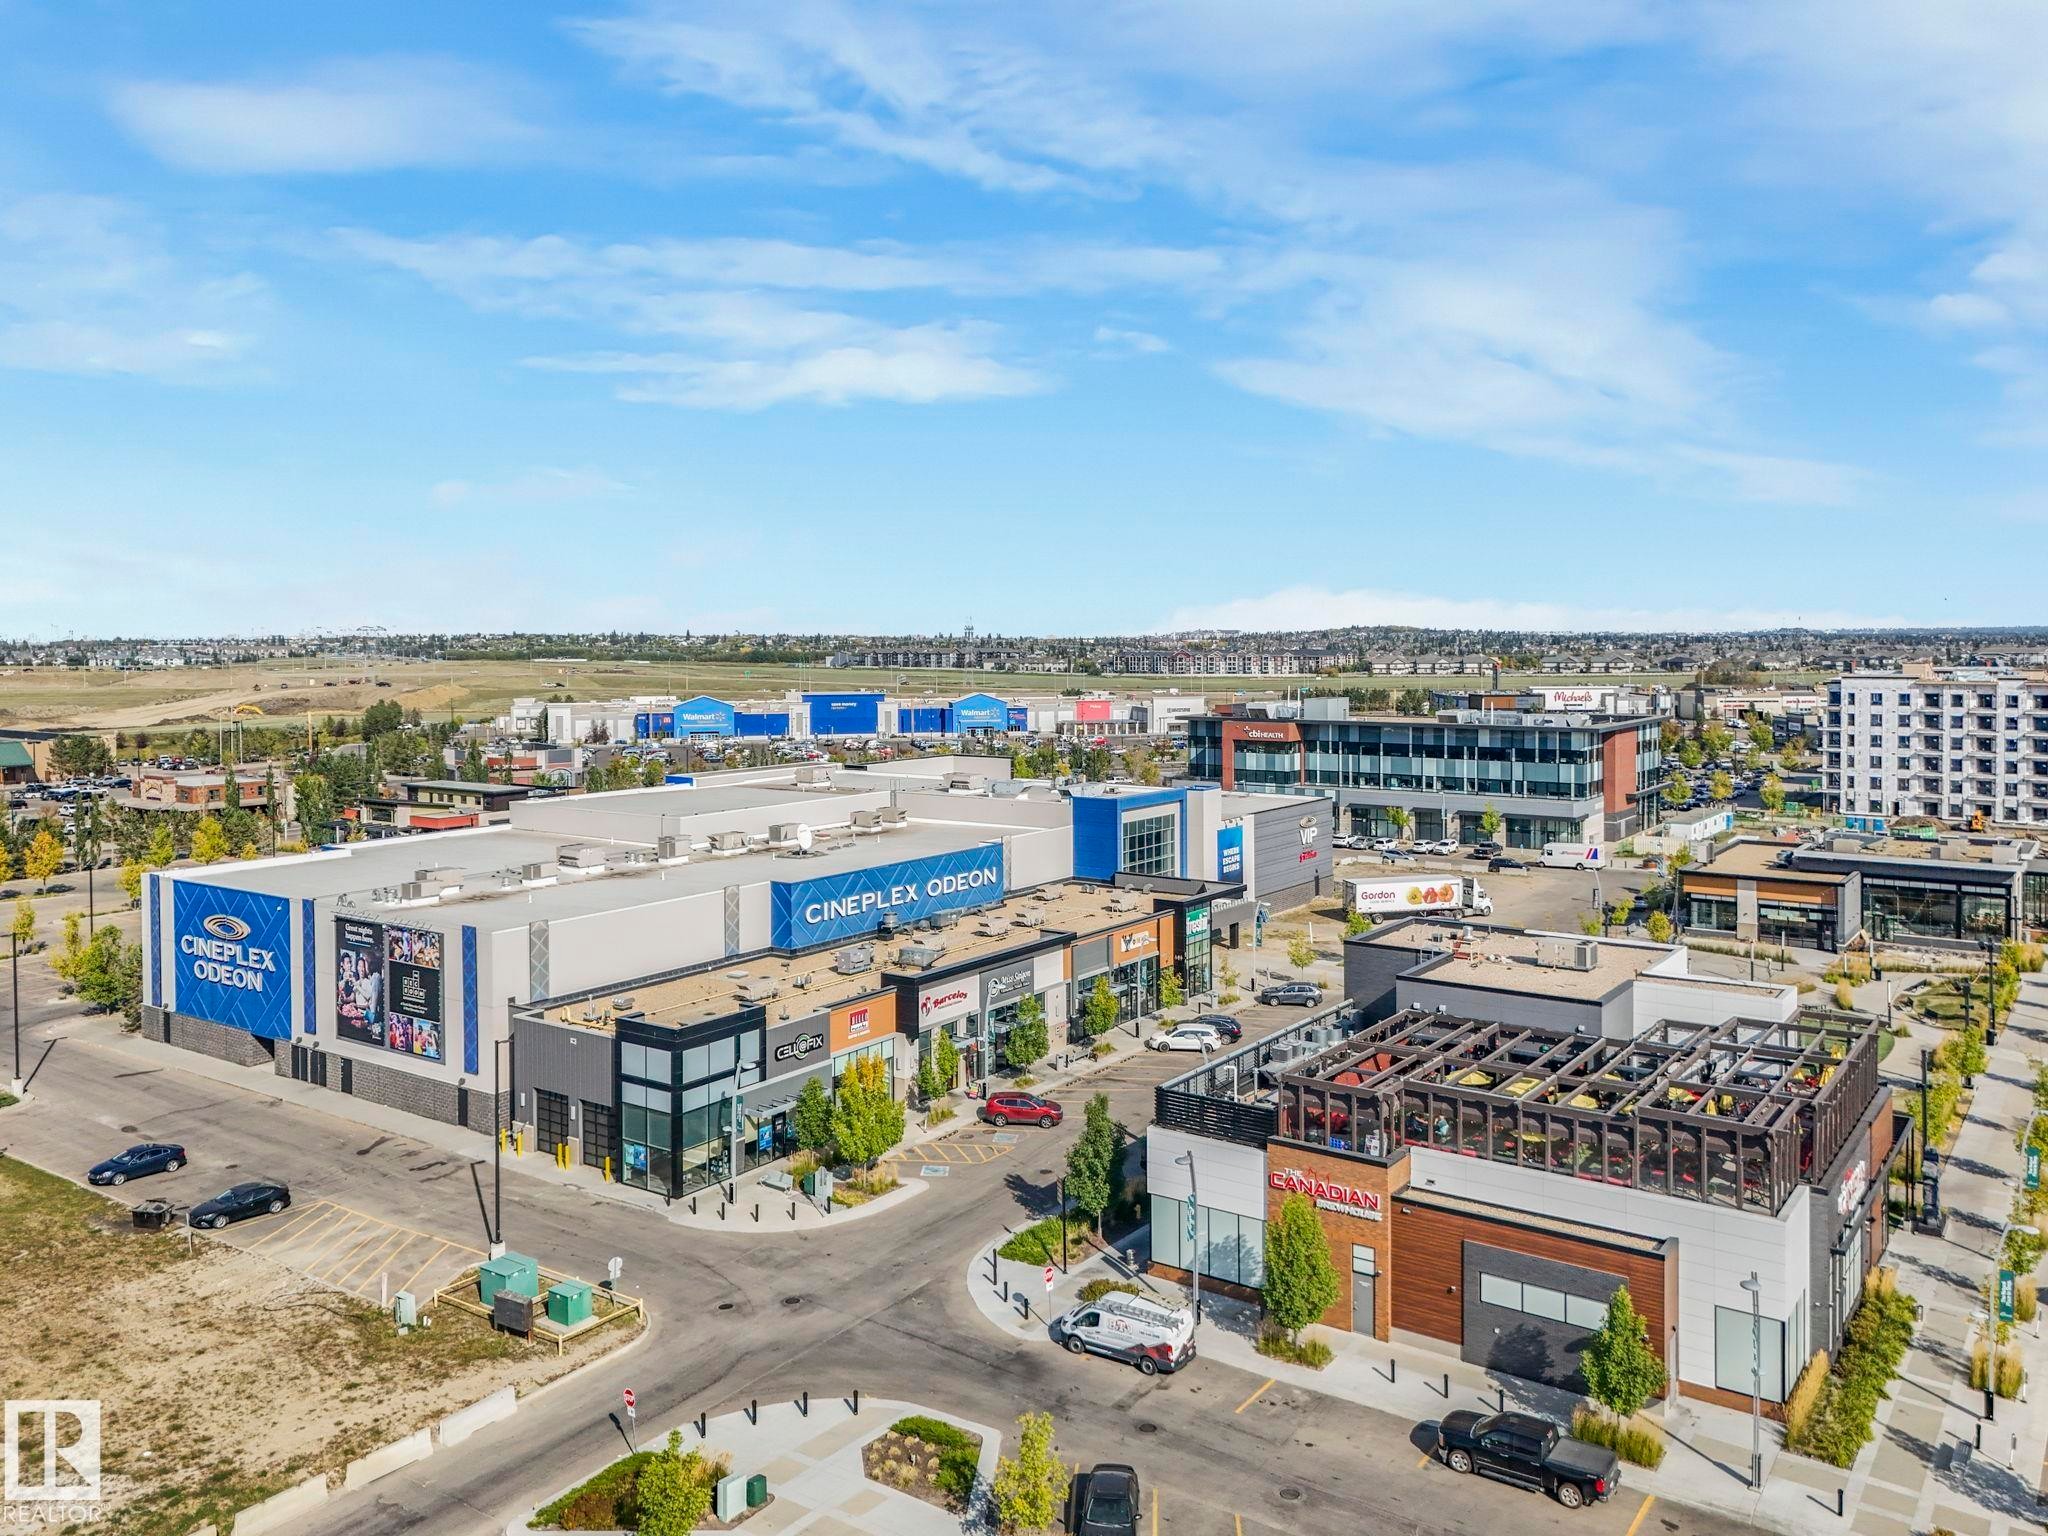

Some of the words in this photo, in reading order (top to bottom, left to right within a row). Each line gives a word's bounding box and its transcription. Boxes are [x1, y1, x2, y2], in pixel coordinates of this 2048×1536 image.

[1554, 691, 1593, 703] Michaels
[683, 713, 716, 721] Walmart
[961, 709, 991, 717] Walmart
[1299, 827, 1318, 845] VIP
[1222, 854, 1240, 865] ESCAPE
[1223, 863, 1240, 874] BEGINS
[805, 884, 919, 925] CINEPLEX
[927, 867, 997, 898] ODEON
[1361, 890, 1396, 900] Gordon
[181, 934, 276, 972] CINEPLEX
[194, 960, 263, 992] ODEON
[933, 990, 968, 1008] Barcelos
[1284, 1167, 1304, 1177] THE
[1270, 1172, 1380, 1210] CANADIAN
